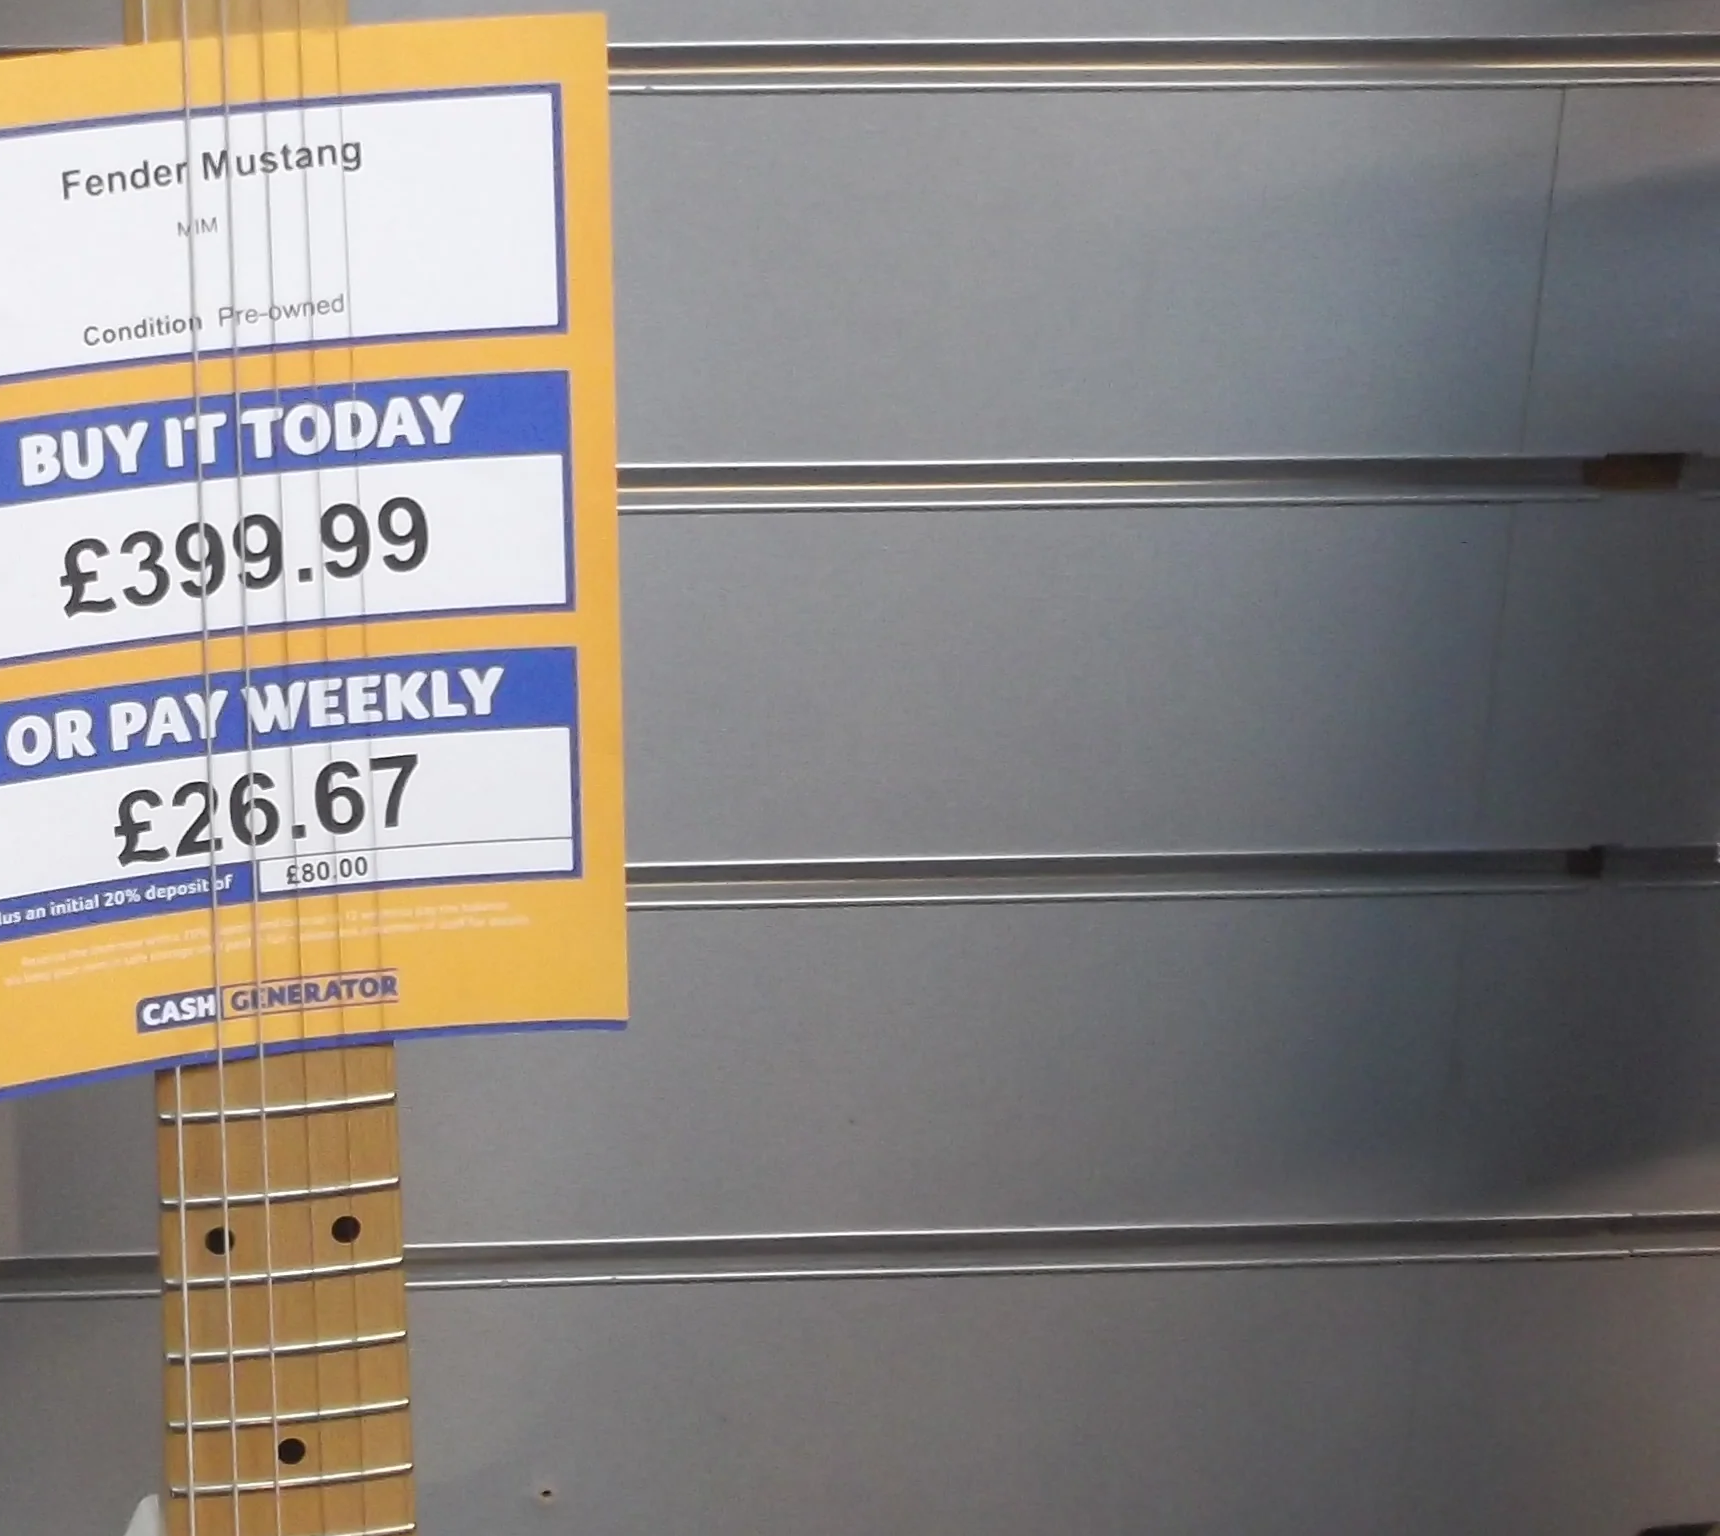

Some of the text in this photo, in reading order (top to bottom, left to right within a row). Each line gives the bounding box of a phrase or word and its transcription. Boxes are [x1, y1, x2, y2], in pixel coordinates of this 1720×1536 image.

[62, 141, 361, 200] Fender Mustang
[83, 294, 344, 346] Condition Pre-owned
[20, 393, 464, 488] BUY IT TODAY
[60, 496, 430, 620] £399.99
[6, 666, 505, 767] OR PAY WEEKLY
[113, 754, 420, 869] £26.67
[25, 905, 46, 921] an
[49, 893, 99, 917] initial
[103, 888, 141, 908] 20%
[145, 879, 210, 903] deposit
[215, 874, 234, 891] of
[286, 857, 368, 885] £80.00
[143, 975, 397, 1026] CASH GENERATOR
